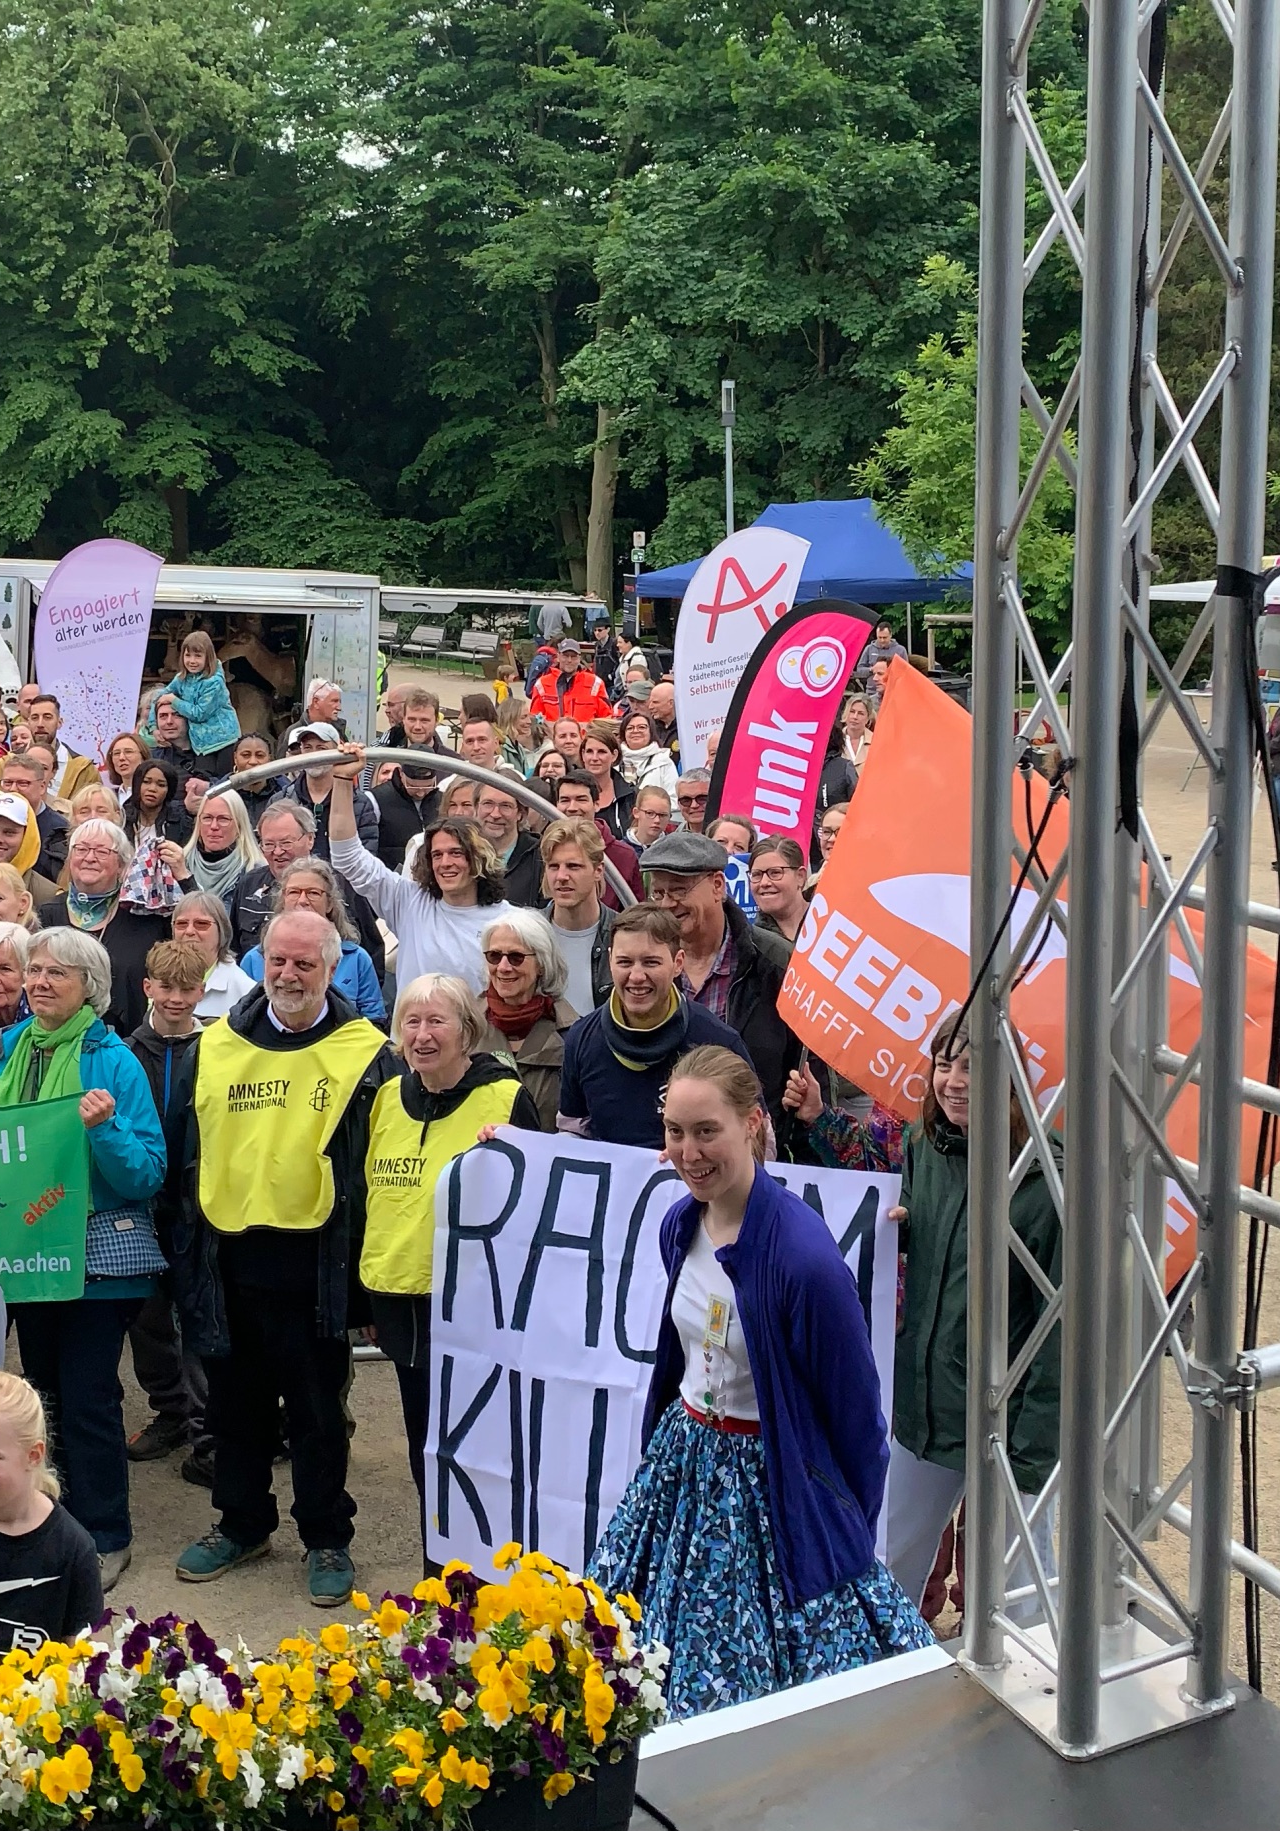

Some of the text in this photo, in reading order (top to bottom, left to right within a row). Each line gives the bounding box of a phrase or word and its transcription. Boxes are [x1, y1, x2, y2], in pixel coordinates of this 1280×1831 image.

[49, 587, 141, 626] Engagiert
[55, 612, 144, 643] älter werden
[692, 659, 727, 672] Alzheimer
[689, 678, 736, 697] Selbsthilfe
[693, 719, 708, 729] Wir
[228, 1080, 290, 1101] AMNESTY
[228, 1097, 287, 1113] INTERNATIONAL
[372, 1157, 428, 1175] AMNESTY
[22, 1183, 66, 1227] aktiv
